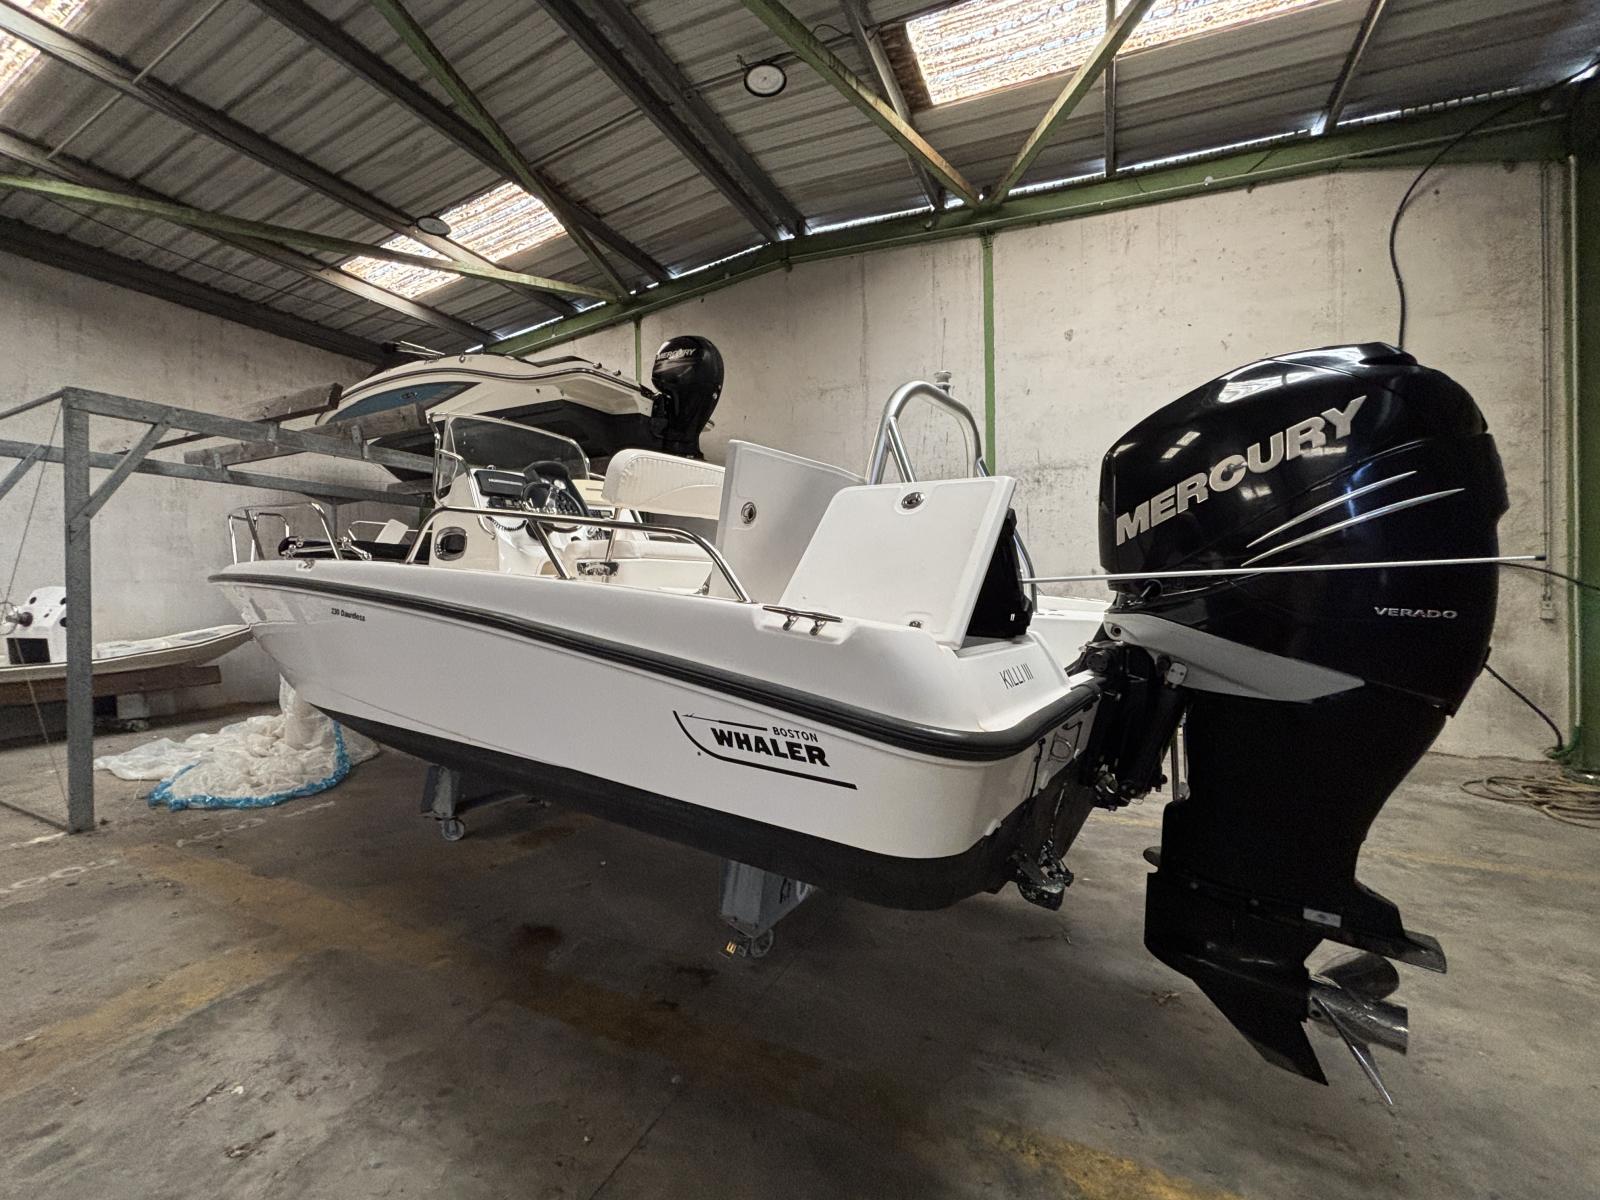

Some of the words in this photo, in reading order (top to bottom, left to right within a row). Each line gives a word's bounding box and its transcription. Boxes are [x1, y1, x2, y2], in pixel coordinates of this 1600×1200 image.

[1116, 395, 1367, 546] MERCURY
[1374, 606, 1458, 619] VERADO
[710, 727, 831, 767] WHALER
[771, 726, 819, 743] BOSTON
